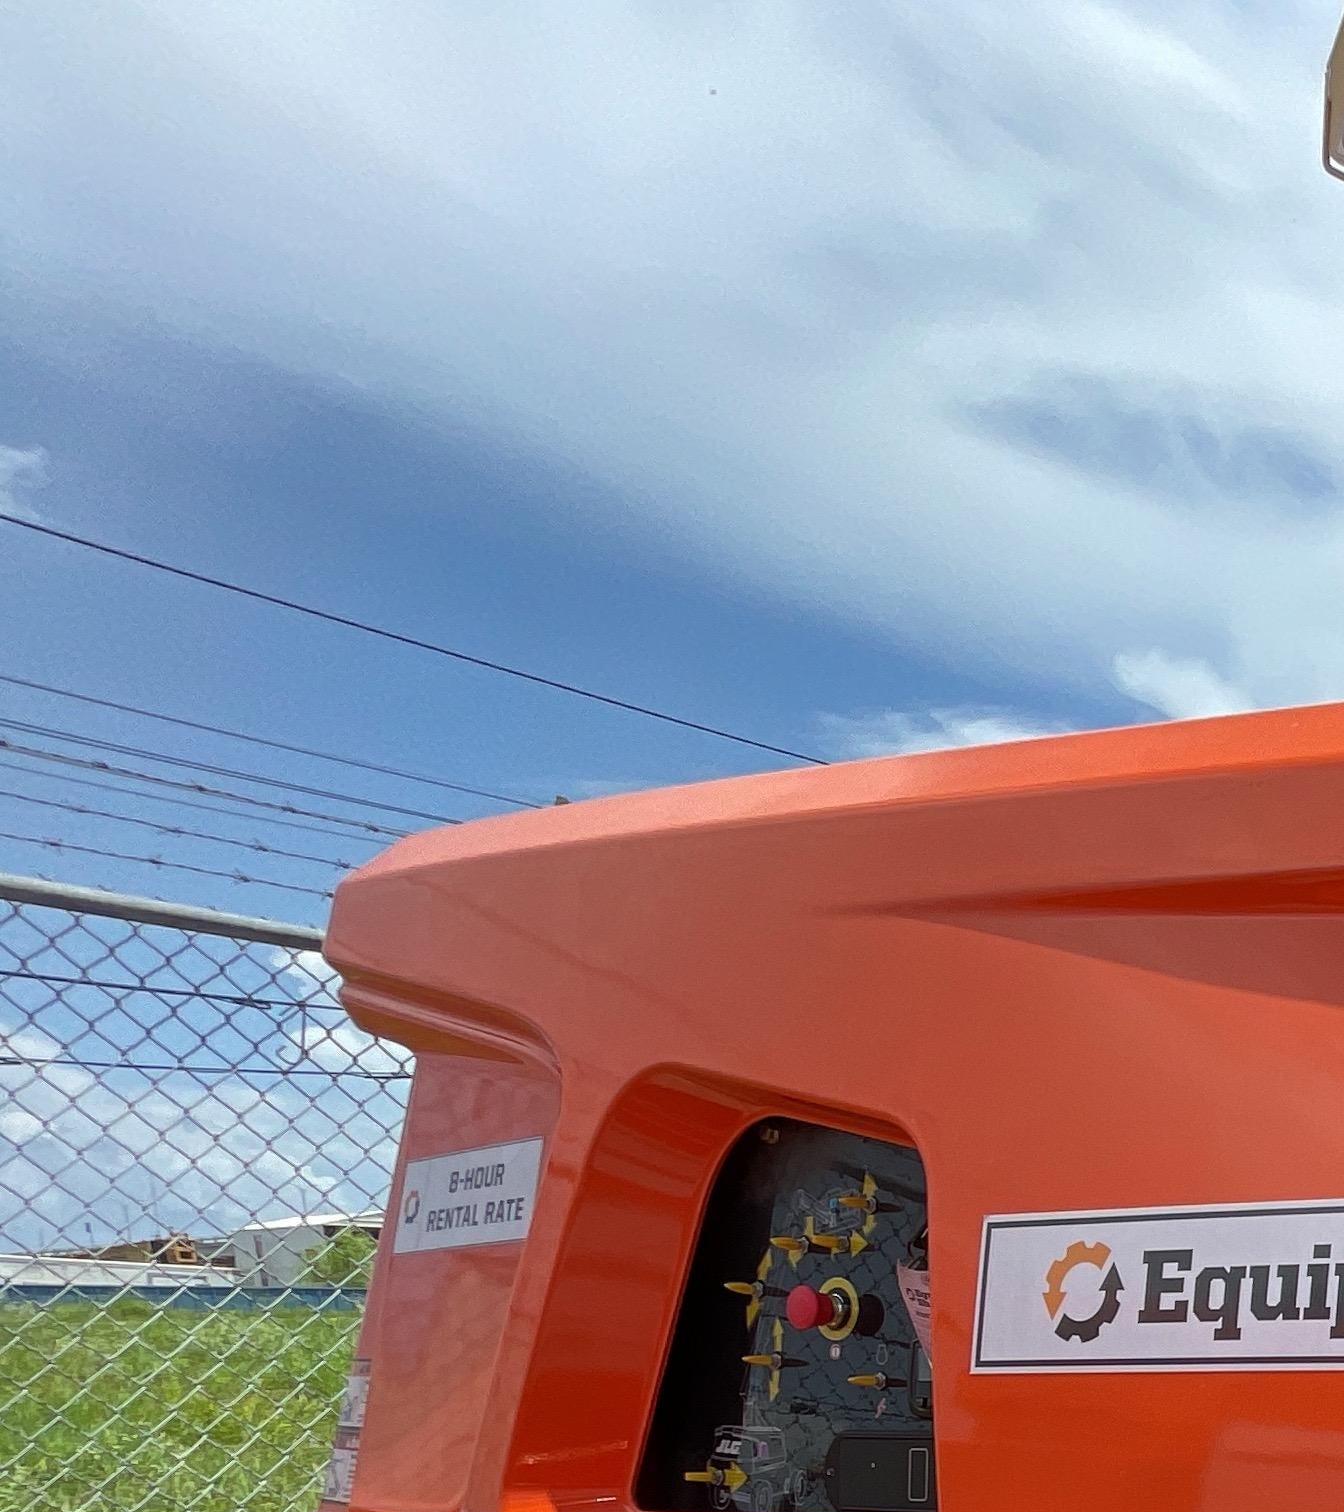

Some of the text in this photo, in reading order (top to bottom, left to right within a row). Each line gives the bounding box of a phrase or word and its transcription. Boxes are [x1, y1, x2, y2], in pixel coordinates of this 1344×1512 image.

[448, 1163, 505, 1194] 8-HOUR
[426, 1196, 526, 1233] RENTAL RATE
[715, 1439, 743, 1455] JLG
